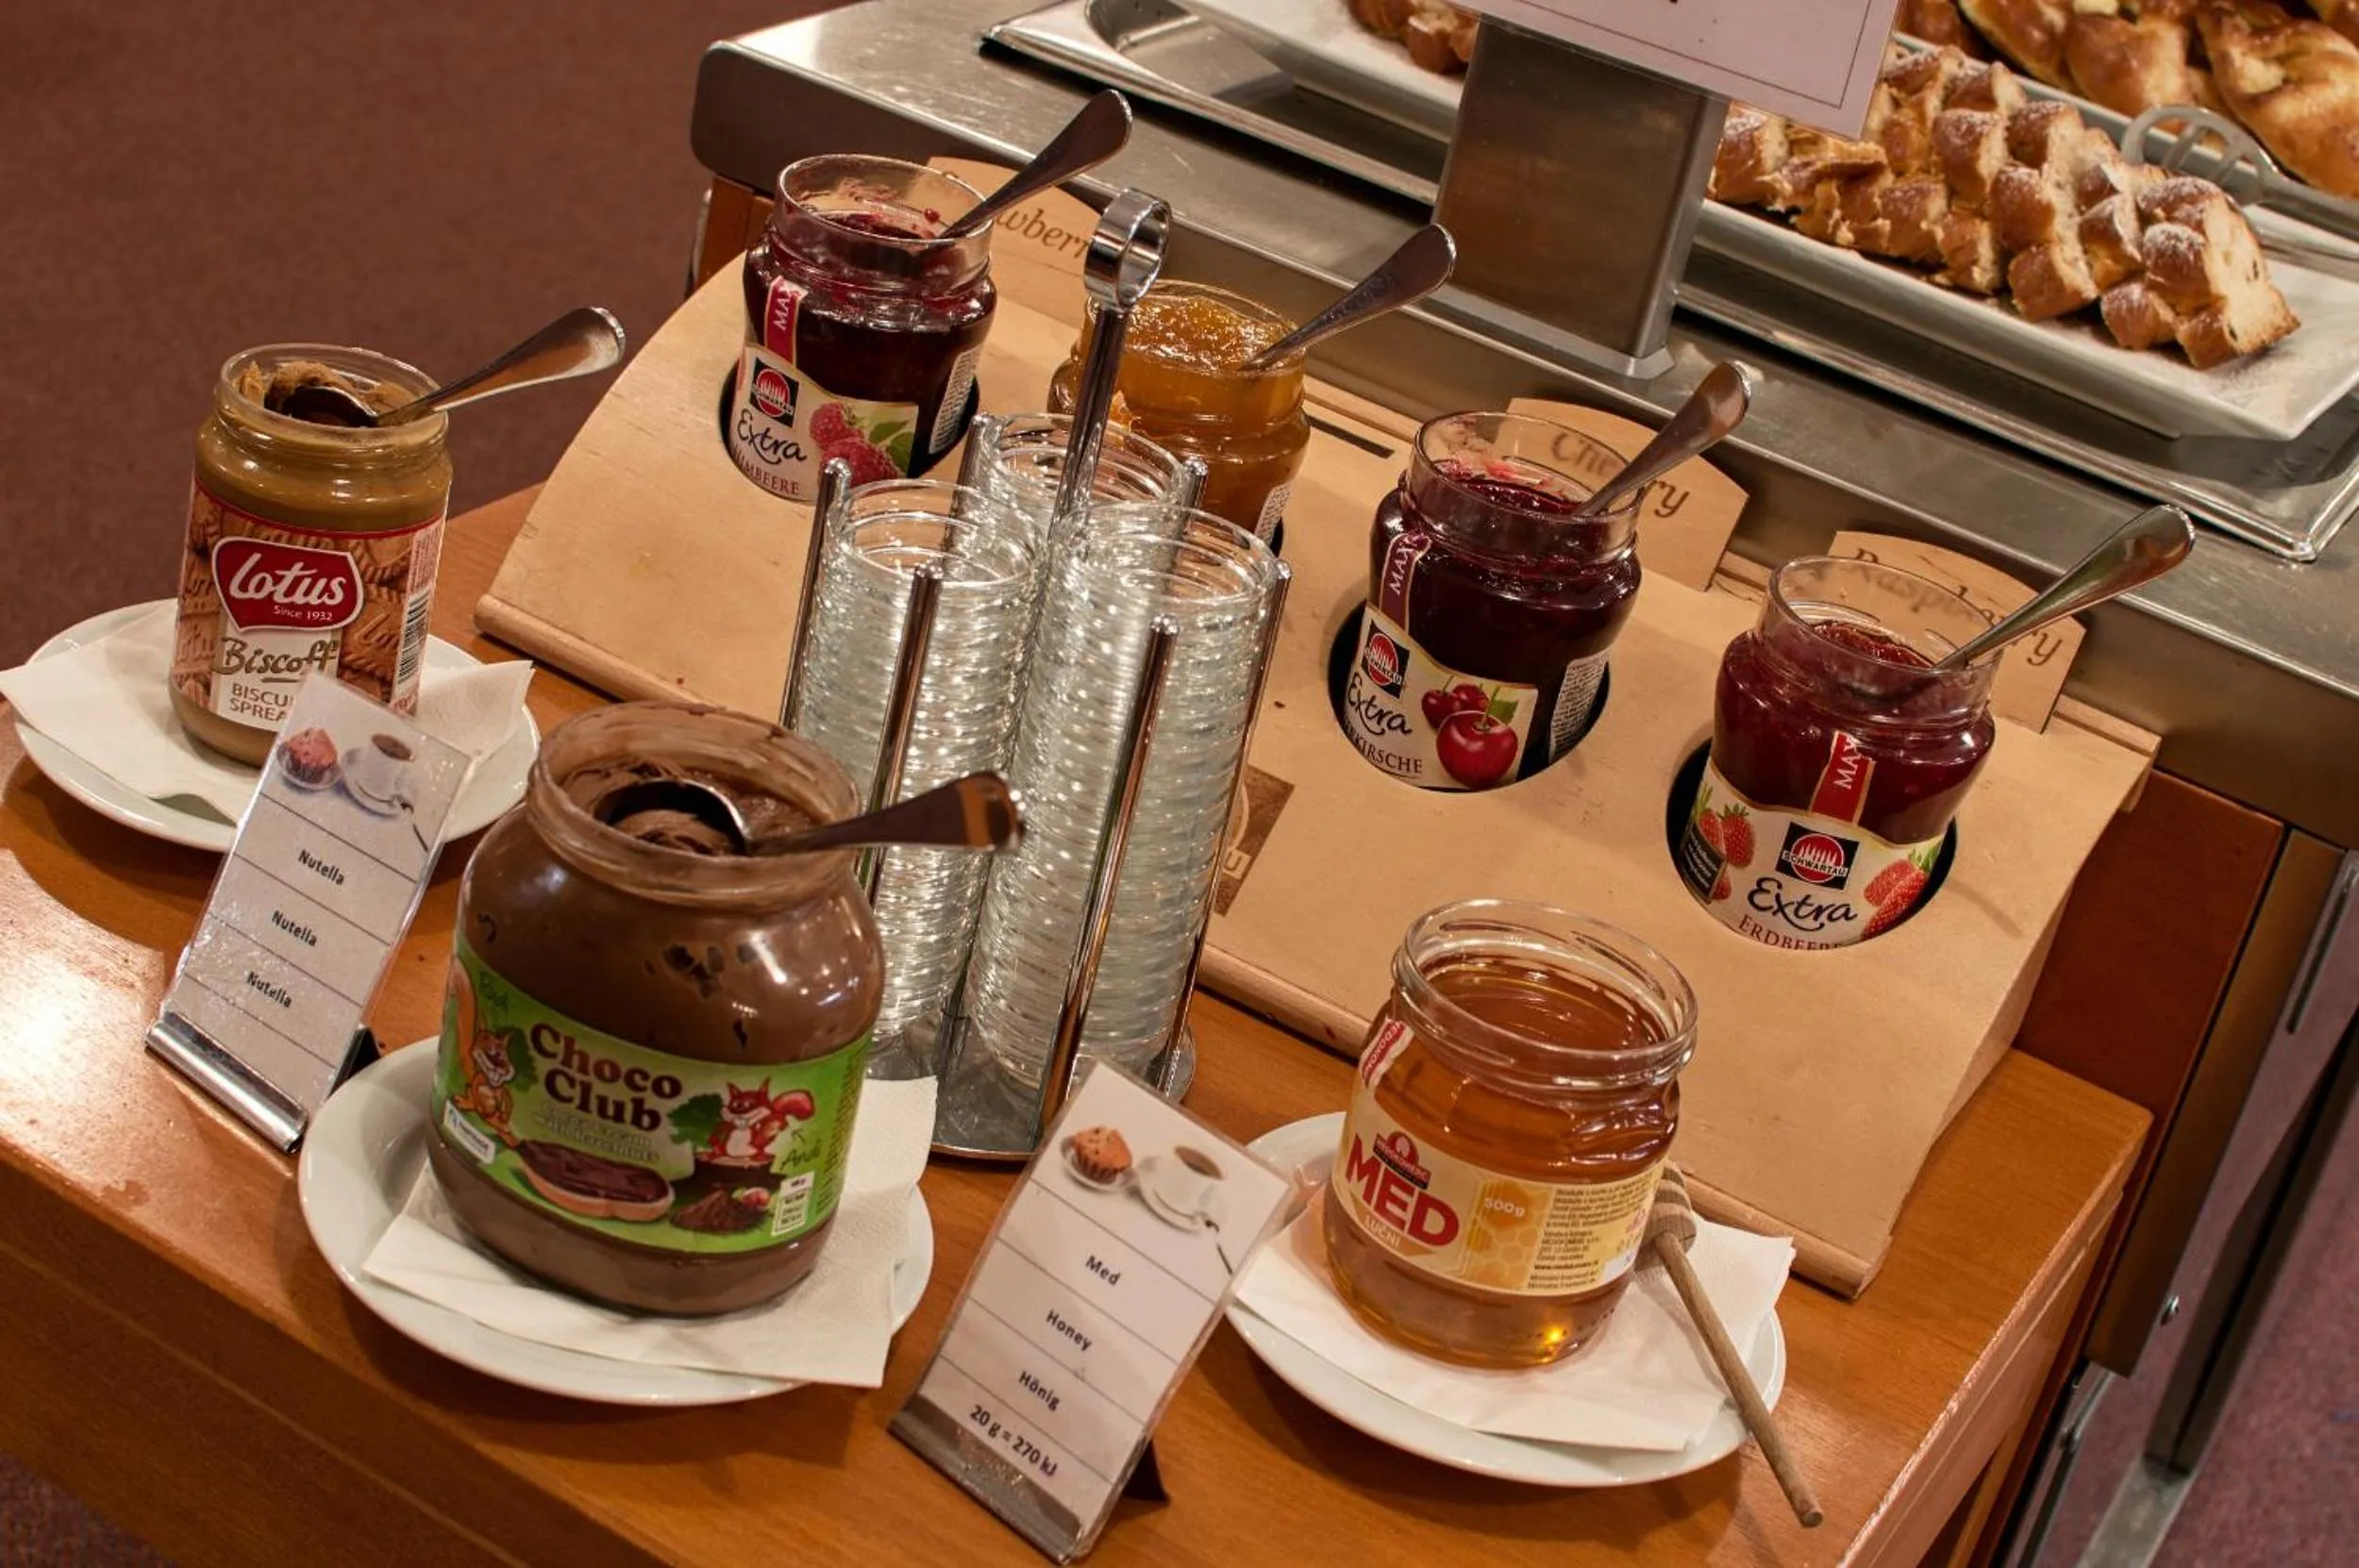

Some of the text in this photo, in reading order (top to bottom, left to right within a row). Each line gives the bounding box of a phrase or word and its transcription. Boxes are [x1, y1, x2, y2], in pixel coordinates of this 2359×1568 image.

[737, 408, 808, 465] Extra
[228, 553, 347, 607] Lotus
[274, 605, 333, 622] Since 1932
[209, 637, 340, 676] Biscoff
[229, 697, 287, 722] SPREA
[1347, 671, 1413, 736] Extra
[297, 849, 345, 885] Nutella
[1781, 850, 1849, 877] SCHWARTAU
[1747, 877, 1858, 932] Extra
[271, 910, 317, 946] Nutella
[245, 972, 293, 1009] Nutella
[530, 1023, 682, 1099] Choco
[544, 1068, 661, 1131] Club
[1346, 1132, 1460, 1247] MED
[1085, 1256, 1121, 1286] Med
[1046, 1309, 1092, 1351] Honey
[970, 1405, 990, 1426] 20
[987, 1423, 1000, 1439] g
[1012, 1437, 1039, 1464] 270
